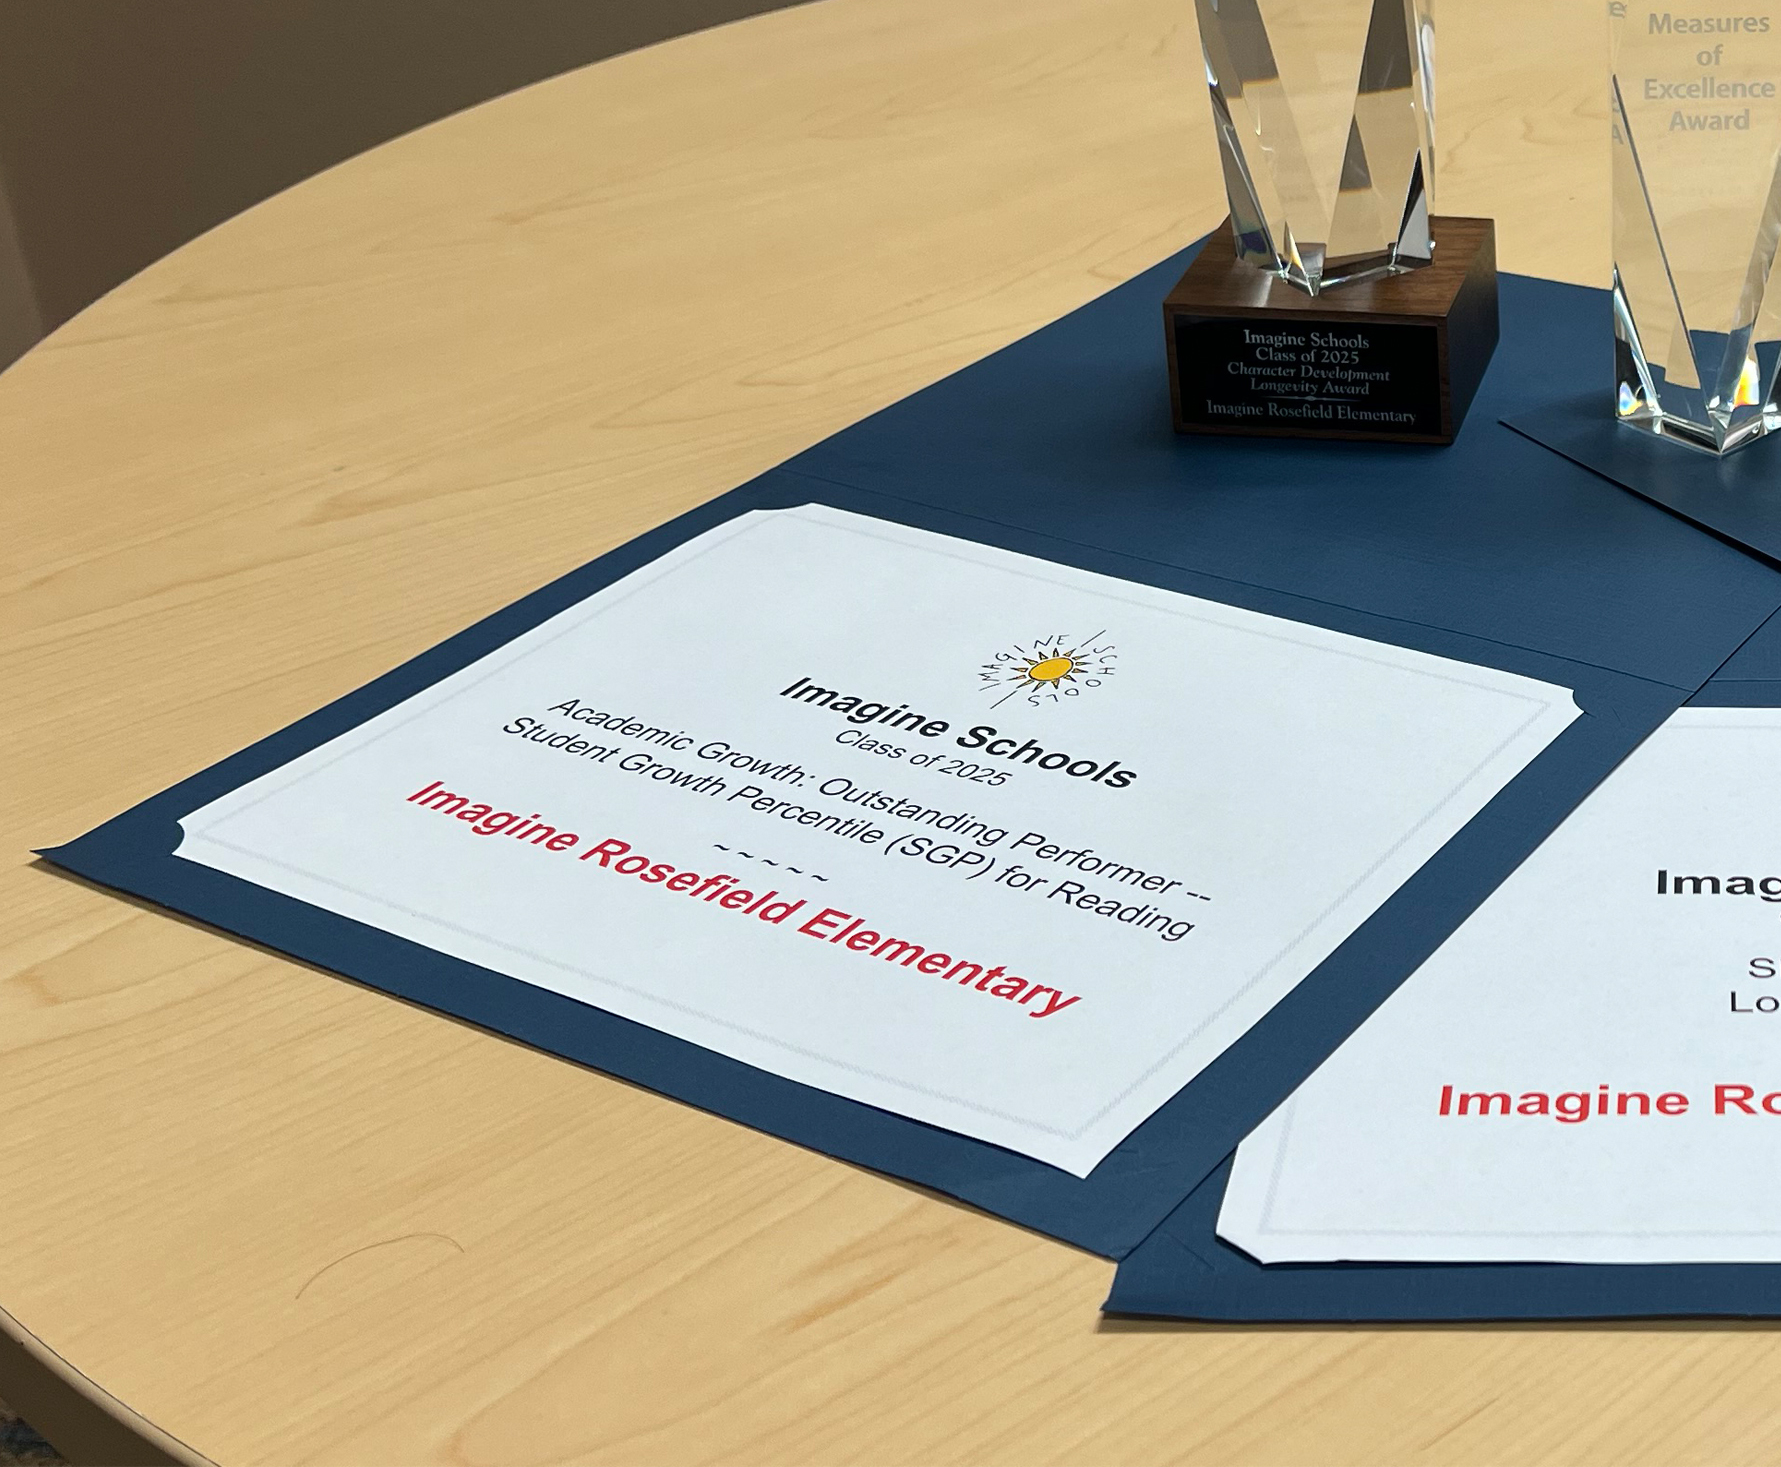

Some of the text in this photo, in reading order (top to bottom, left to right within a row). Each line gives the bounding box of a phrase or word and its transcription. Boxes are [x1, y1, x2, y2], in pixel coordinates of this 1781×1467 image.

[1648, 12, 1770, 35] Measures
[1695, 43, 1724, 67] of
[1643, 77, 1776, 101] Excellence
[1668, 108, 1750, 132] Award
[1243, 329, 1370, 349] Imagine Schools
[1255, 346, 1359, 365] Class of 2025
[1227, 361, 1390, 383] Character Development
[1250, 377, 1370, 396] Longevity Award
[1207, 399, 1416, 426] Imagine Rosefield Elementary
[780, 676, 1138, 788] Imagine Schools
[835, 729, 1014, 787] Class of 2025
[548, 698, 1182, 896] Academic Growth: Outstanding Performer
[502, 716, 1196, 943] Student Growth Percentile (SGP) for Reading
[406, 780, 1083, 1019] Imagine Rosefield Elementary
[1438, 1084, 1690, 1123] Imagine
